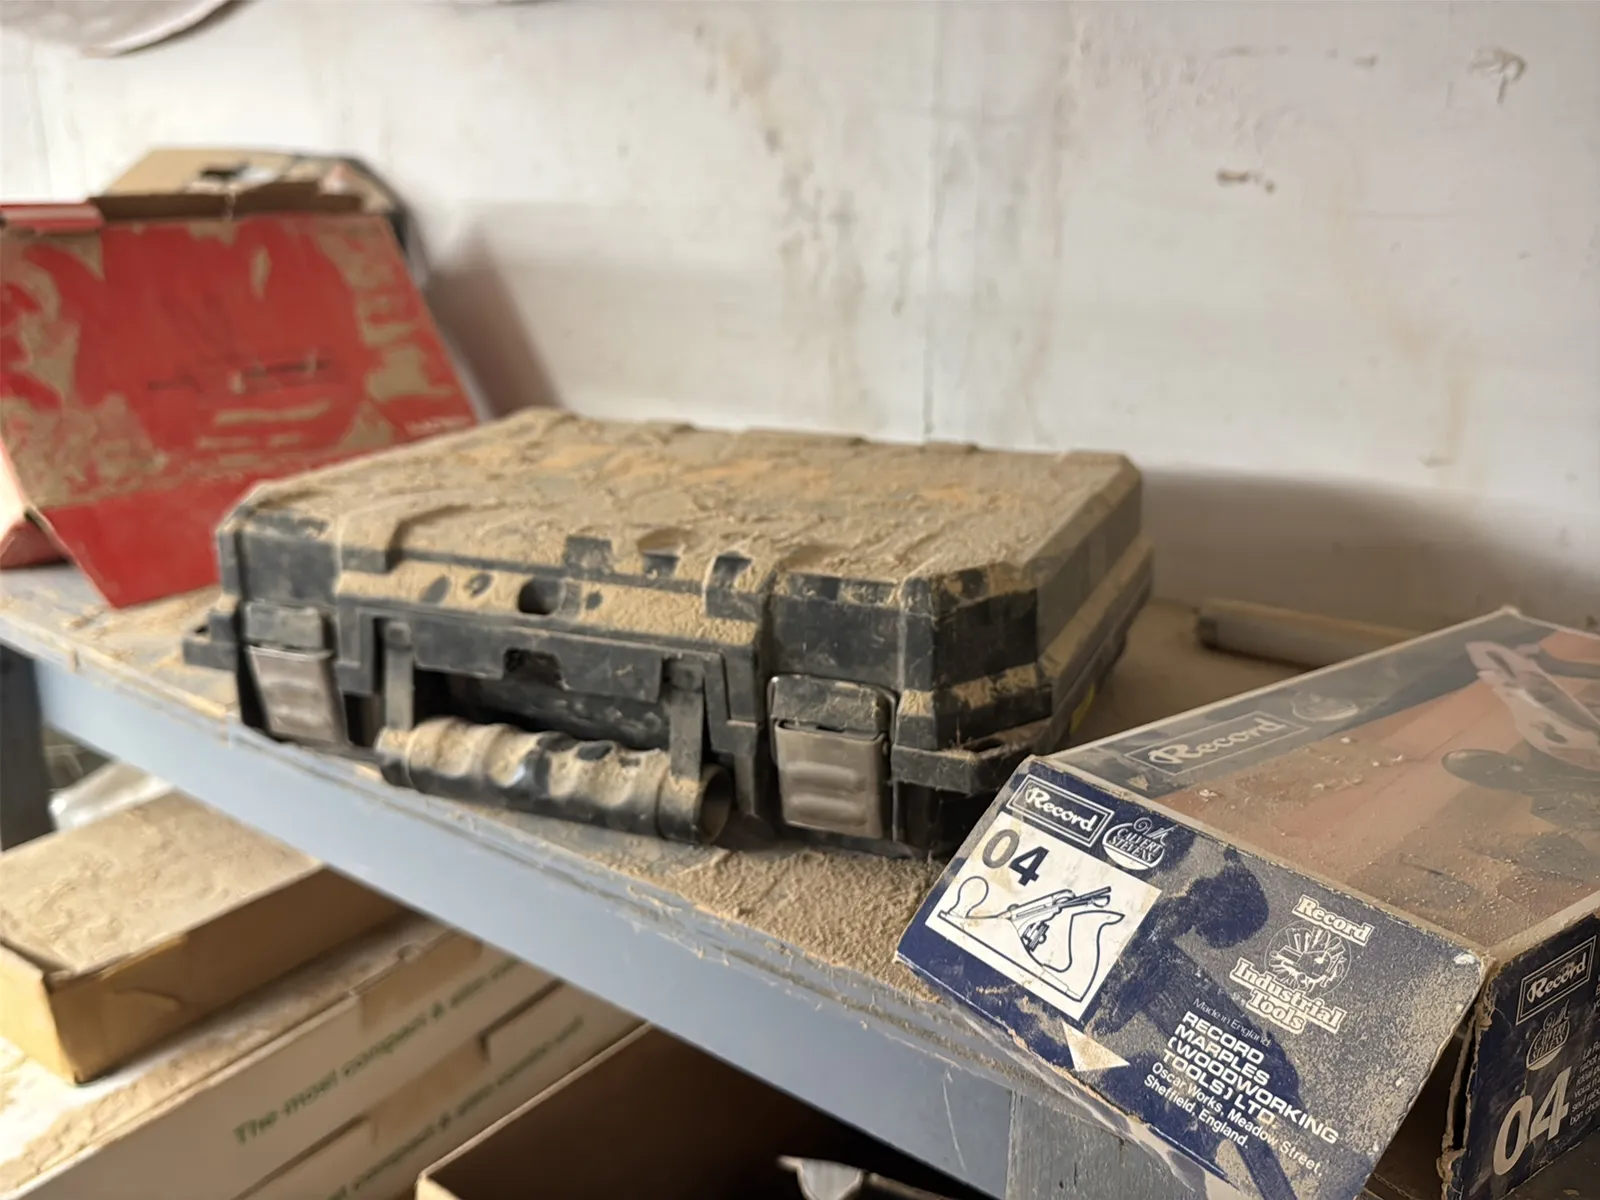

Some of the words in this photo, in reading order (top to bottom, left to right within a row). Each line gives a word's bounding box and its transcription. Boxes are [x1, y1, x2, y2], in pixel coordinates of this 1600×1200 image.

[1149, 718, 1286, 765] Record
[1025, 785, 1098, 832] Record
[982, 829, 1049, 886] 04
[1108, 835, 1156, 863] STEVENS
[1116, 828, 1164, 855] CALVERT
[1292, 894, 1375, 947] Record
[1229, 957, 1348, 1034] Industrial
[1526, 952, 1587, 1003] Record
[1193, 998, 1221, 1019] Made
[1230, 1016, 1272, 1048] England
[1246, 988, 1306, 1034] Tools
[1174, 1023, 1271, 1086] MARPLES
[1182, 1010, 1265, 1065] RECORD
[1163, 1049, 1234, 1100] TOOLS)
[1167, 1036, 1340, 1144] (WOODWORKING
[1574, 1081, 1591, 1099] vous
[233, 1109, 280, 1146] The
[1144, 1074, 1196, 1118] Sheffield,
[1198, 1107, 1250, 1150] England.
[1152, 1062, 1187, 1089] Oscar
[1188, 1084, 1224, 1116] Works,
[1227, 1108, 1279, 1148] Meadow
[1493, 1066, 1571, 1176] 04
[1569, 1110, 1584, 1126] bon
